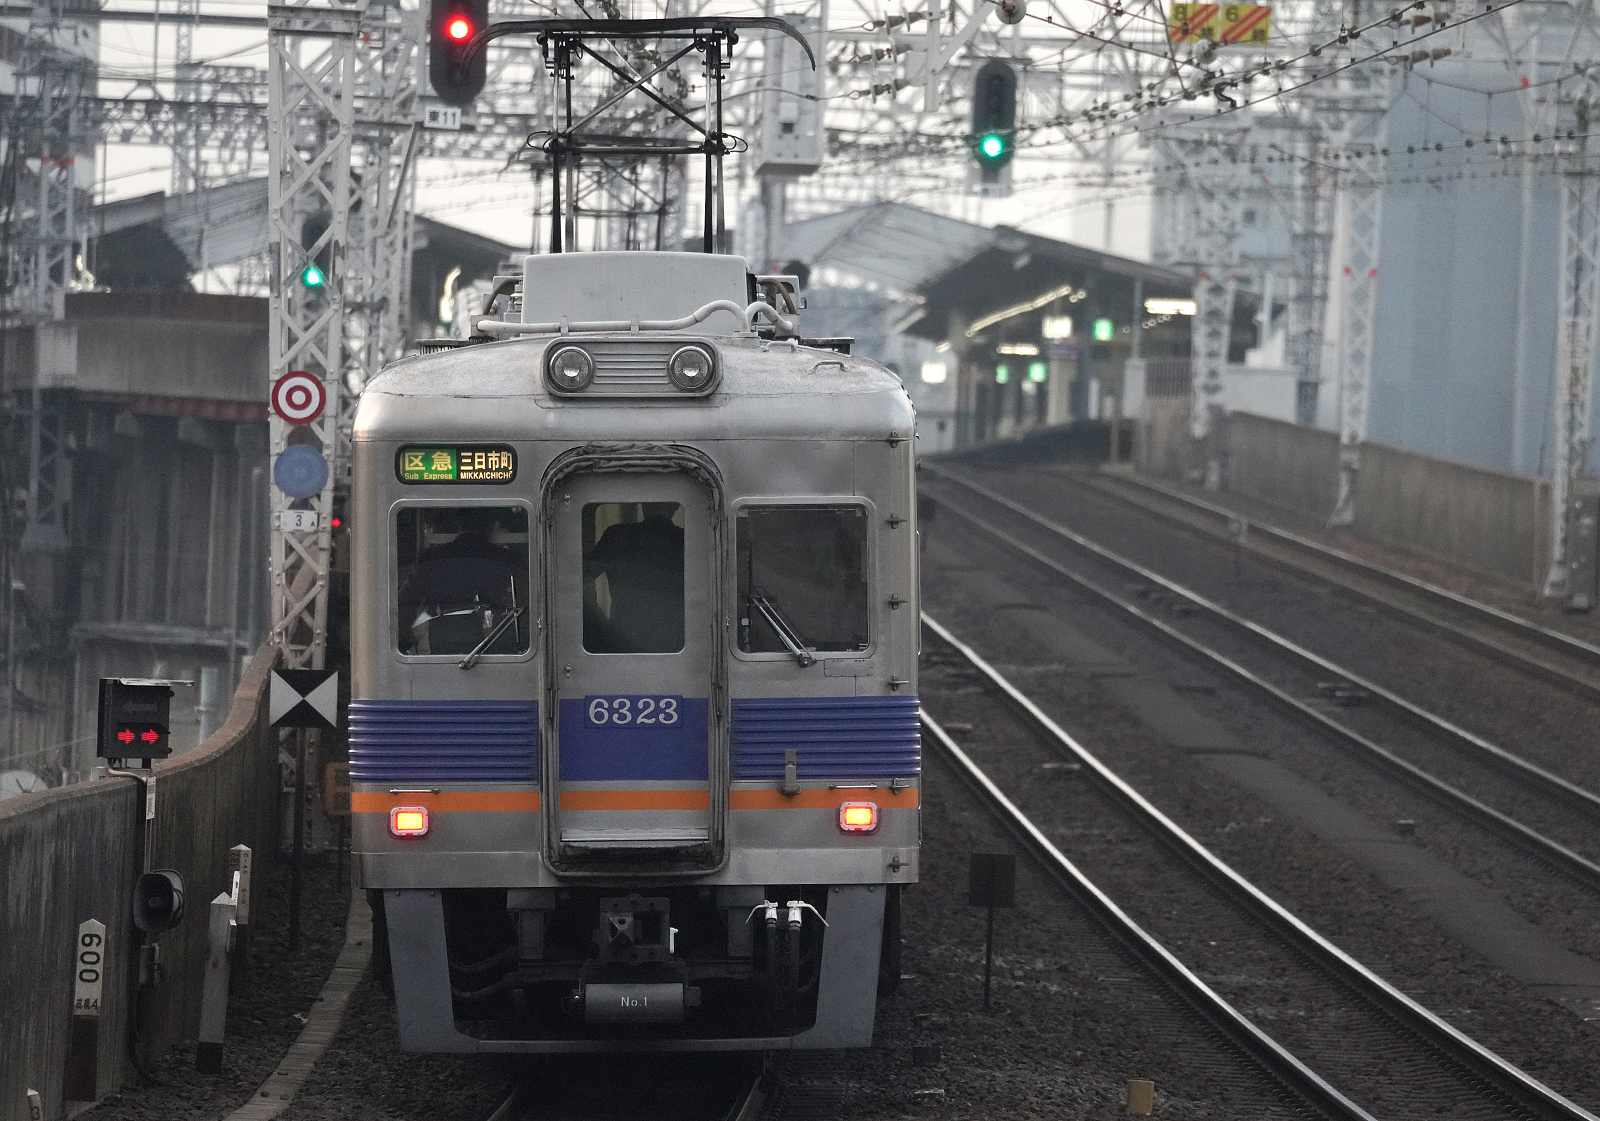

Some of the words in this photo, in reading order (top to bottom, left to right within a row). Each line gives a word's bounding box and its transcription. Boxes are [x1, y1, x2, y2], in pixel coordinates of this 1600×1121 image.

[1225, 5, 1239, 22] 6
[404, 451, 453, 471] 区急
[460, 450, 513, 471] 三日市町
[295, 514, 302, 527] 3
[588, 698, 679, 725] 6323
[621, 996, 648, 1007] No.1
